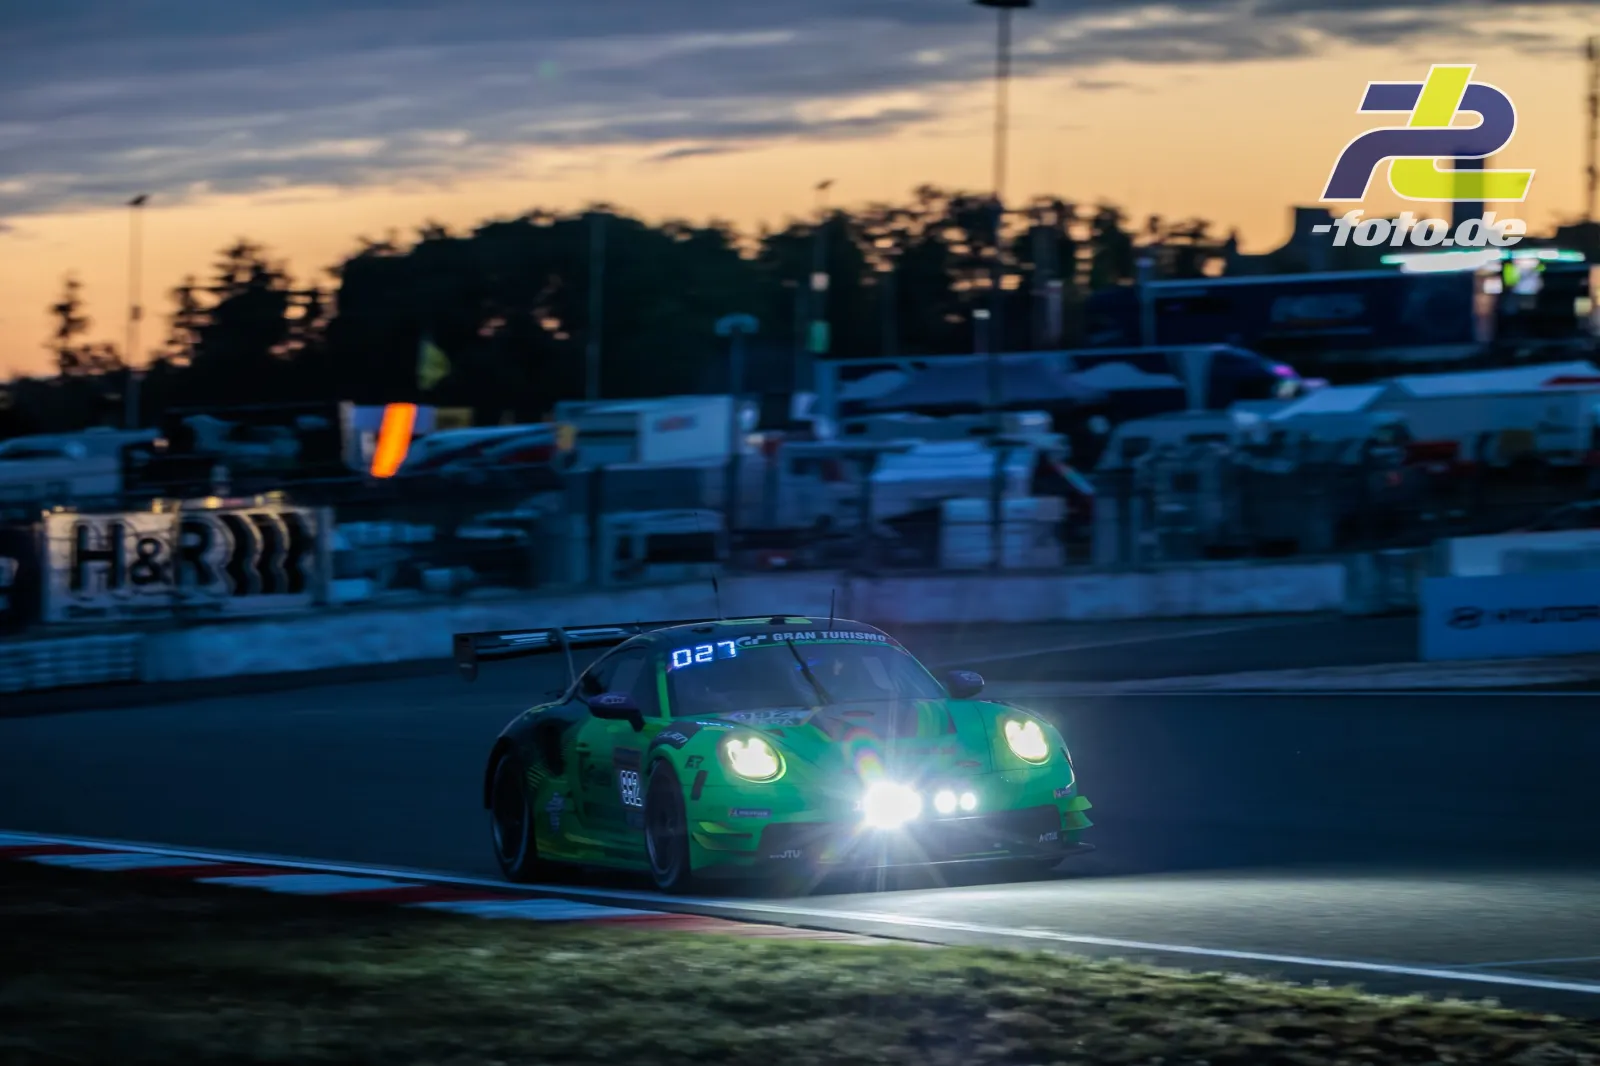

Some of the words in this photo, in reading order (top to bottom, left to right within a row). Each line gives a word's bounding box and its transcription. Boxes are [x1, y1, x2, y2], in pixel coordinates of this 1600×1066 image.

[69, 519, 218, 590] H&R
[772, 631, 816, 643] GRAN
[820, 630, 888, 643] TURISMO
[671, 640, 738, 669] 027
